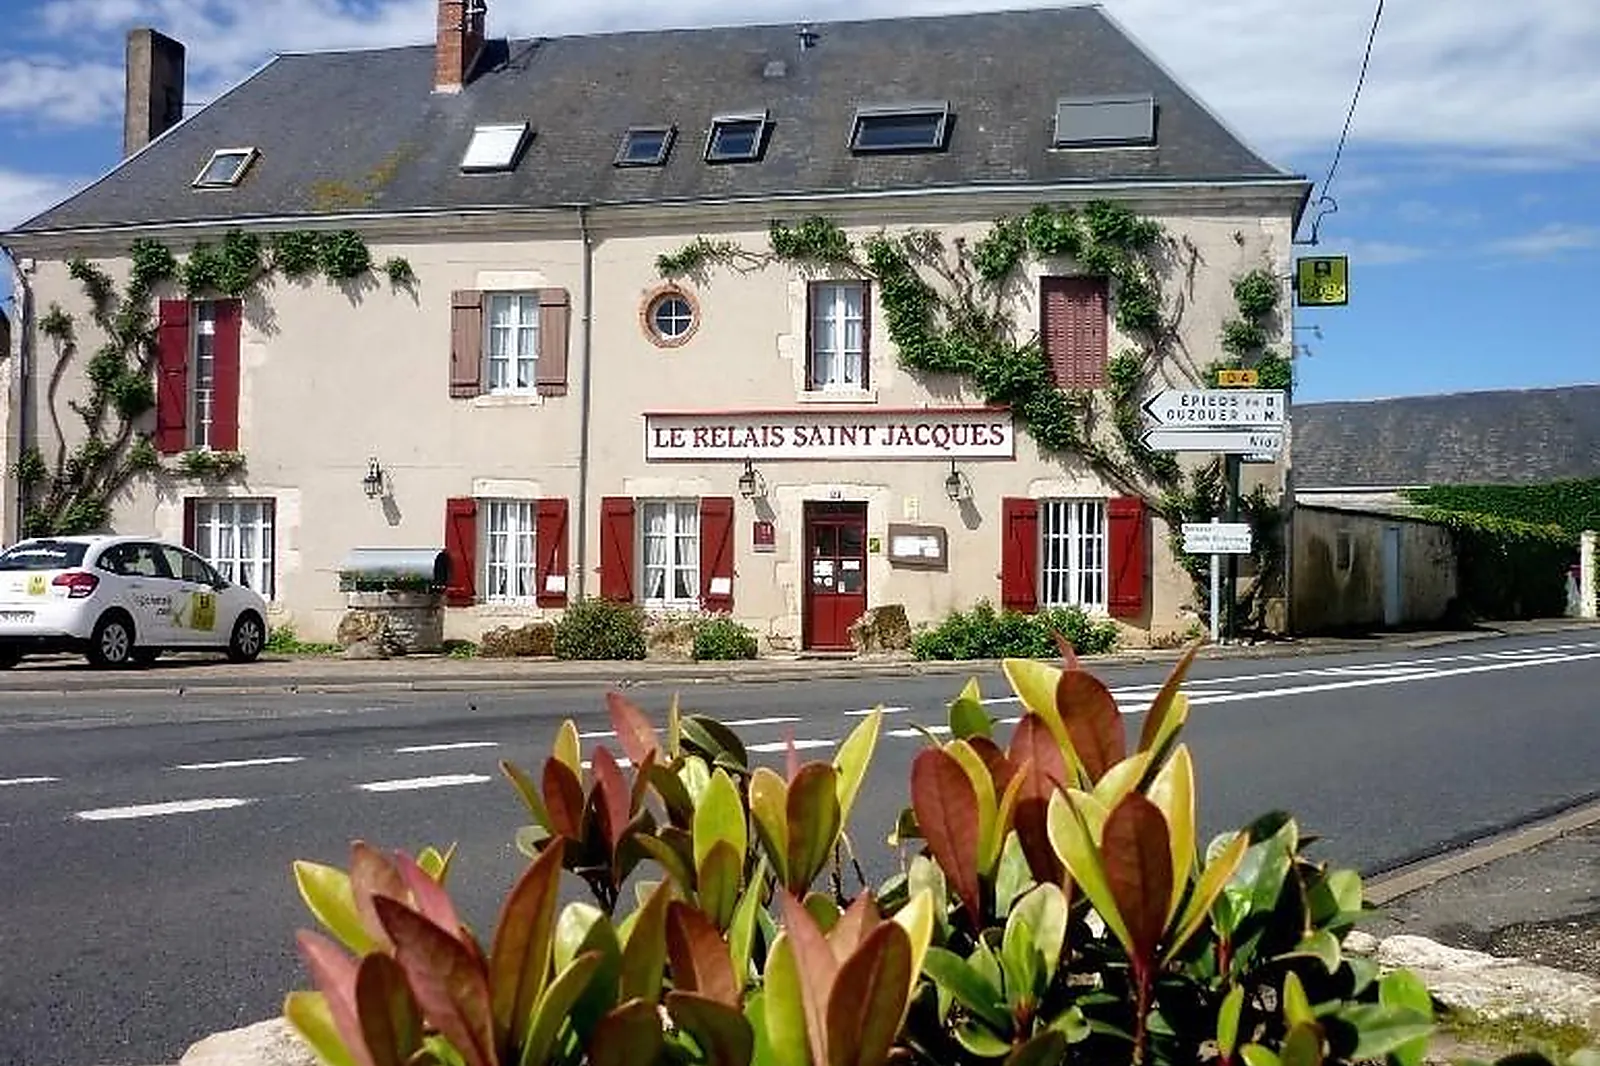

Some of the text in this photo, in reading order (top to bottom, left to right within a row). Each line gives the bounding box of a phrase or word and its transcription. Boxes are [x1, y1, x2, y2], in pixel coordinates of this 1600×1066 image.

[654, 423, 1006, 450] LE RELAIS SAINT JACQUES
